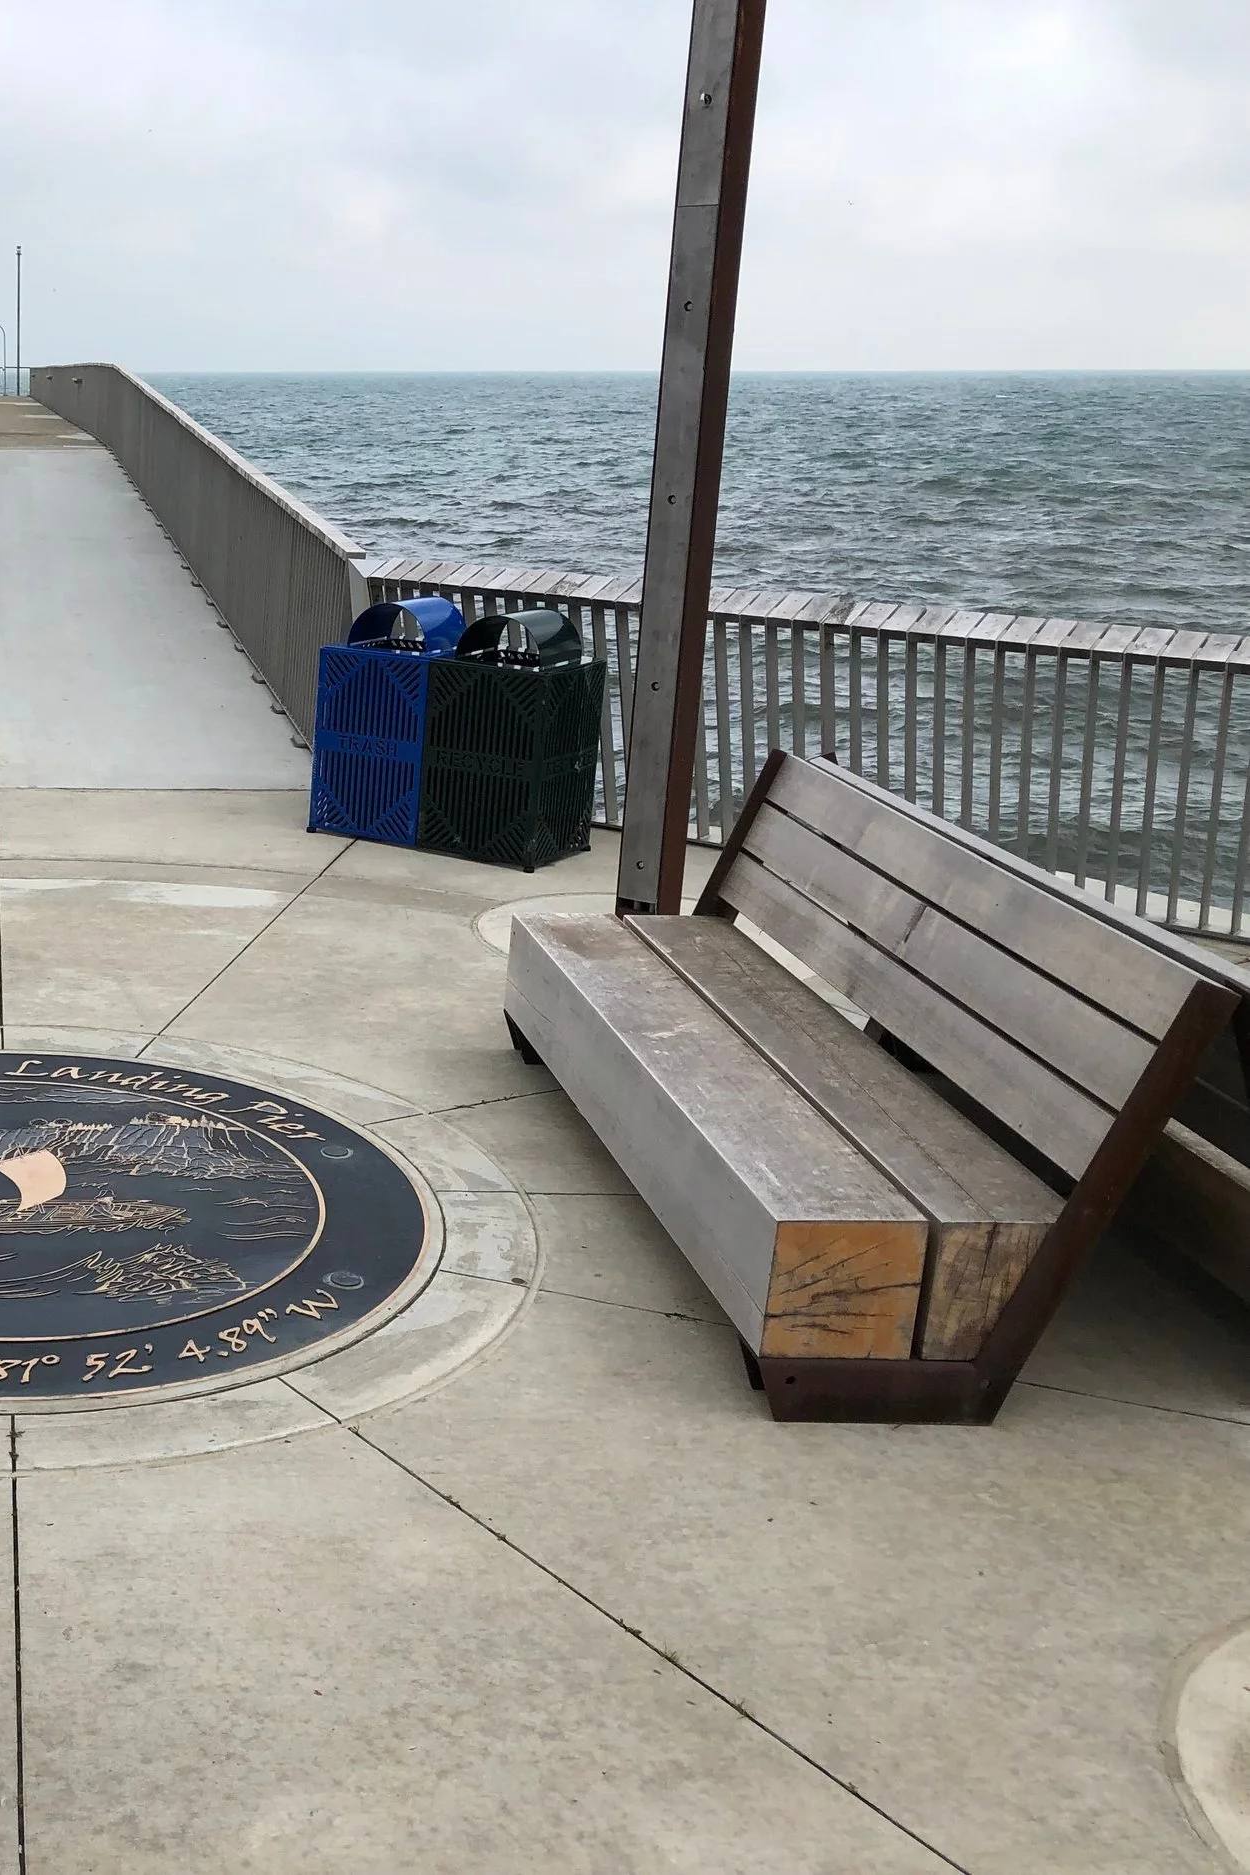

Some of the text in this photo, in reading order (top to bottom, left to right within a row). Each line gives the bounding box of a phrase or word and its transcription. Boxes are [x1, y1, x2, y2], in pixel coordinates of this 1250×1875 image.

[338, 735, 398, 758] TRASH
[436, 750, 525, 778] RECYCLE
[5, 1060, 231, 1107] Landing
[218, 1100, 327, 1142] Pier
[285, 1288, 340, 1321] W
